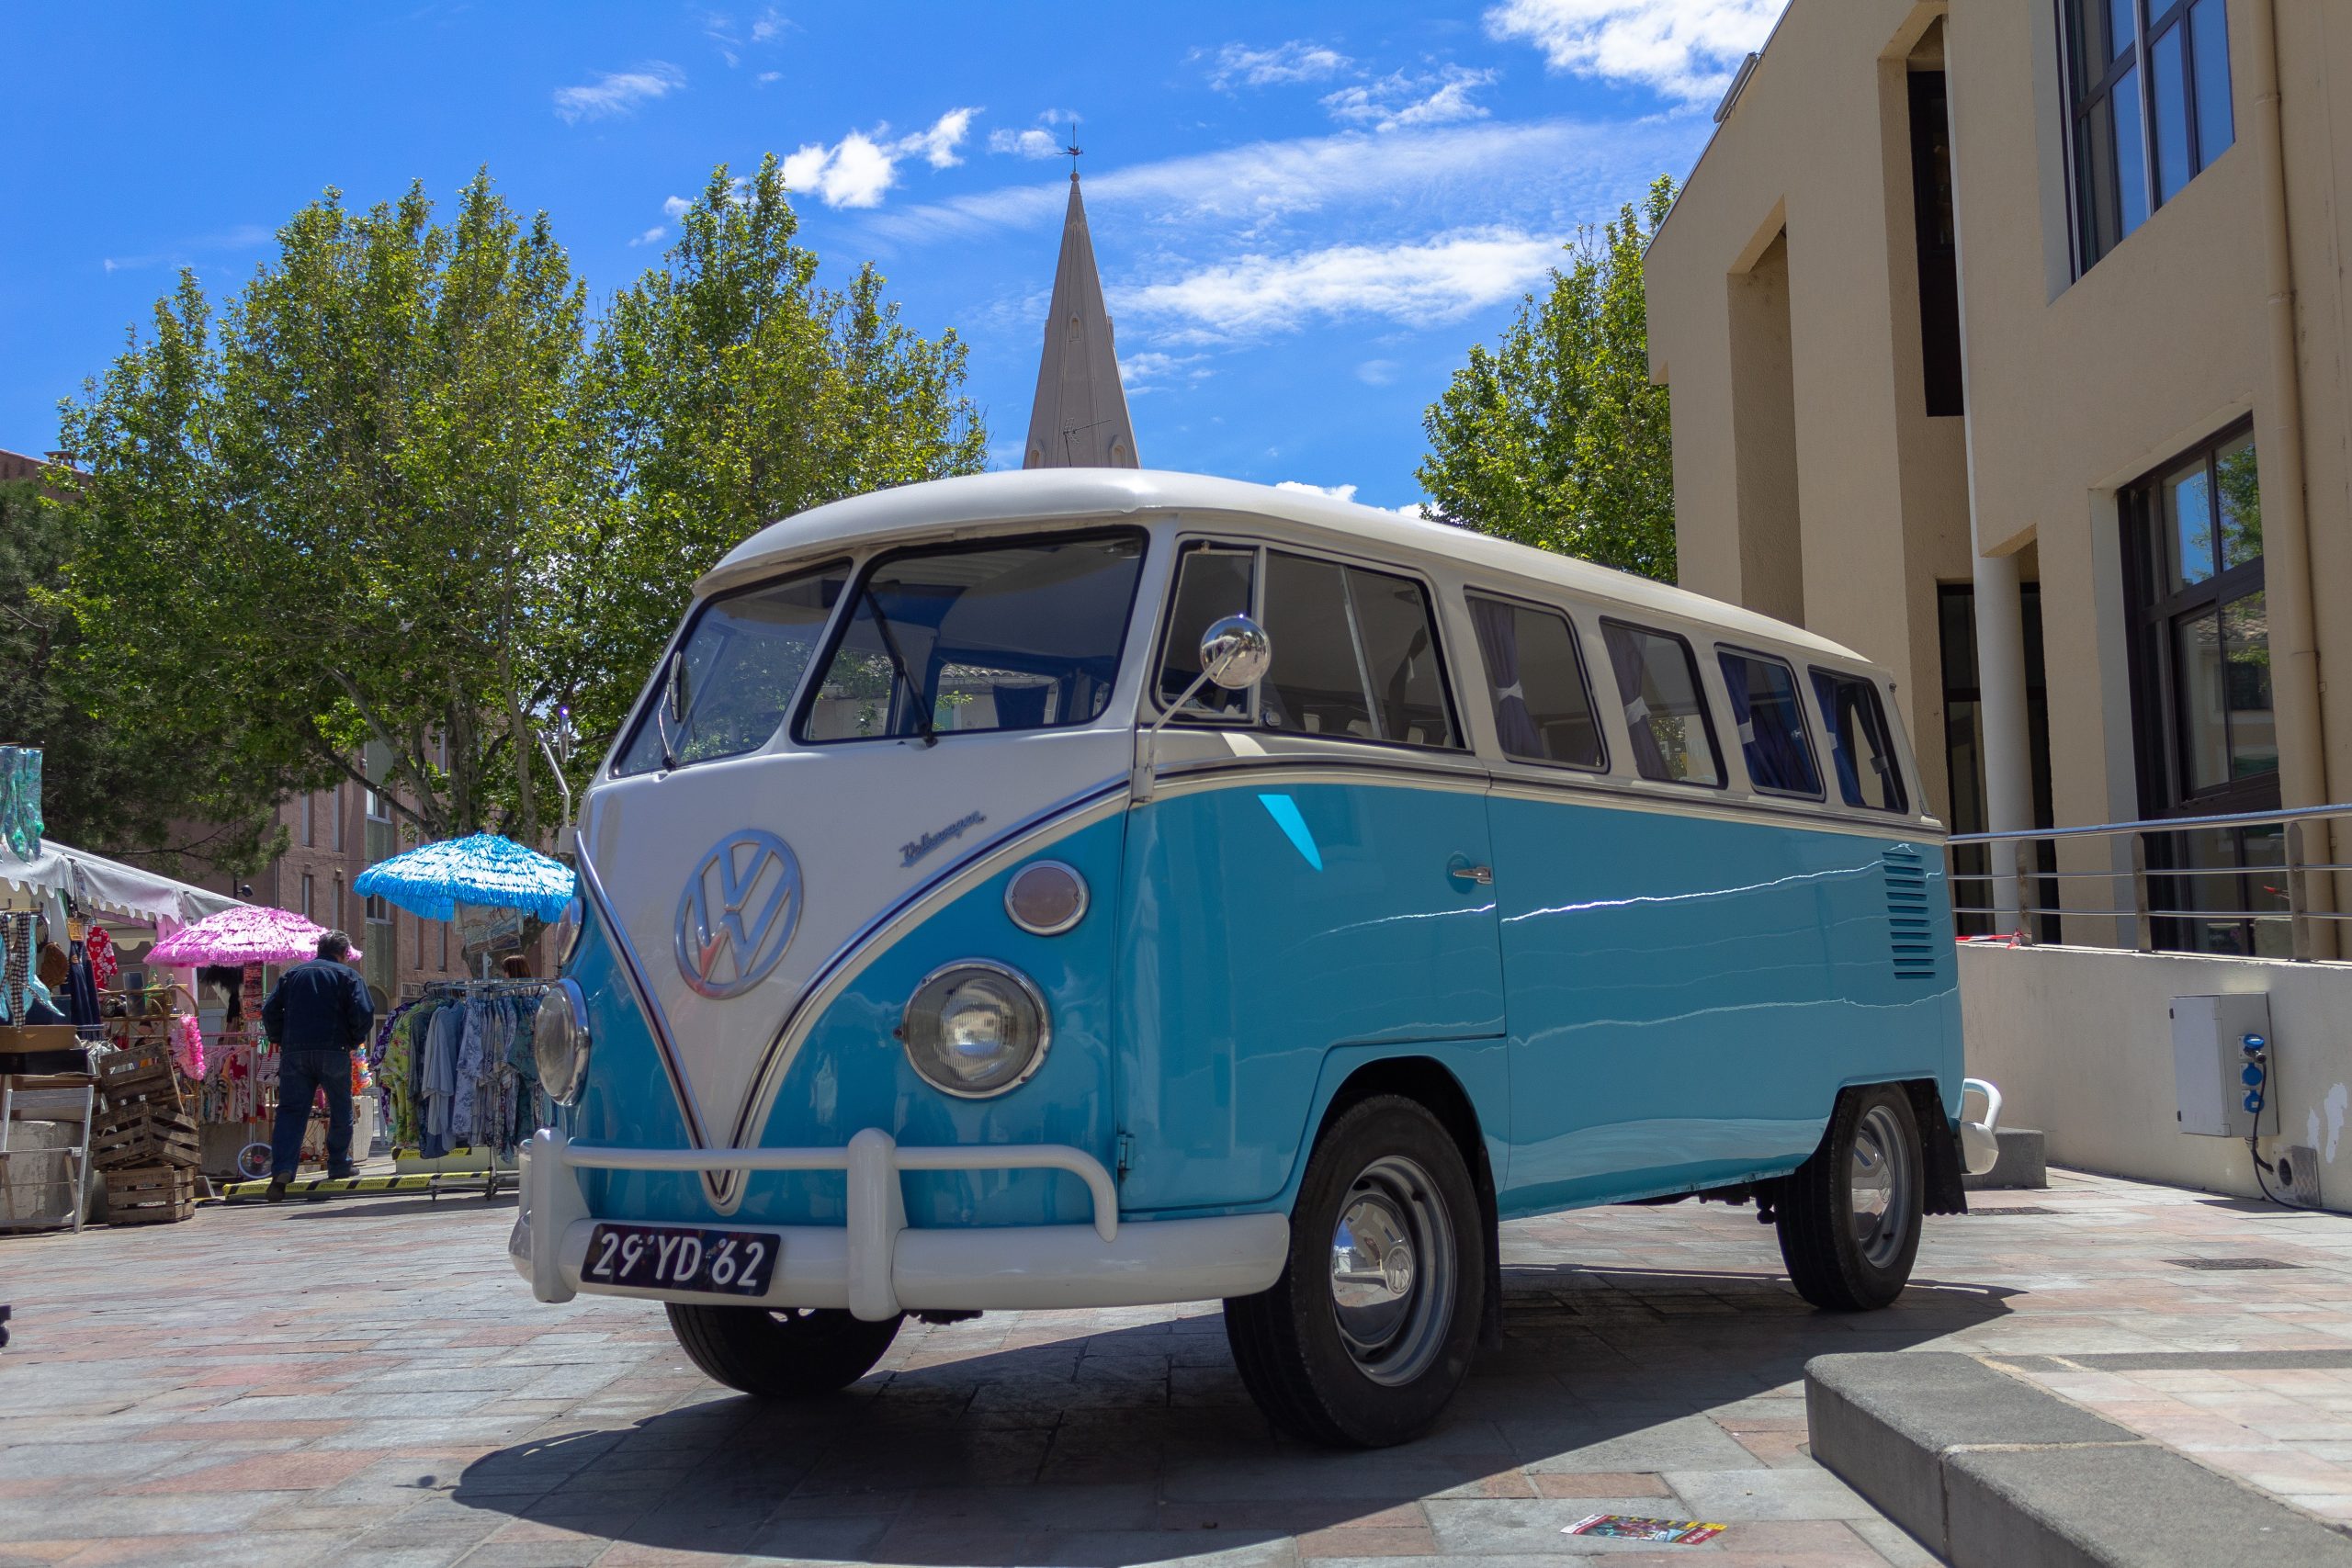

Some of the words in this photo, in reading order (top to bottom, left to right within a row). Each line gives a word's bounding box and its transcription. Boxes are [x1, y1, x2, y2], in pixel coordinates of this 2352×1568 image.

[899, 810, 987, 867] Volkswagen
[673, 829, 804, 1000] VW
[593, 1233, 644, 1278] 29
[655, 1235, 702, 1281] YD
[712, 1240, 764, 1287] 62
